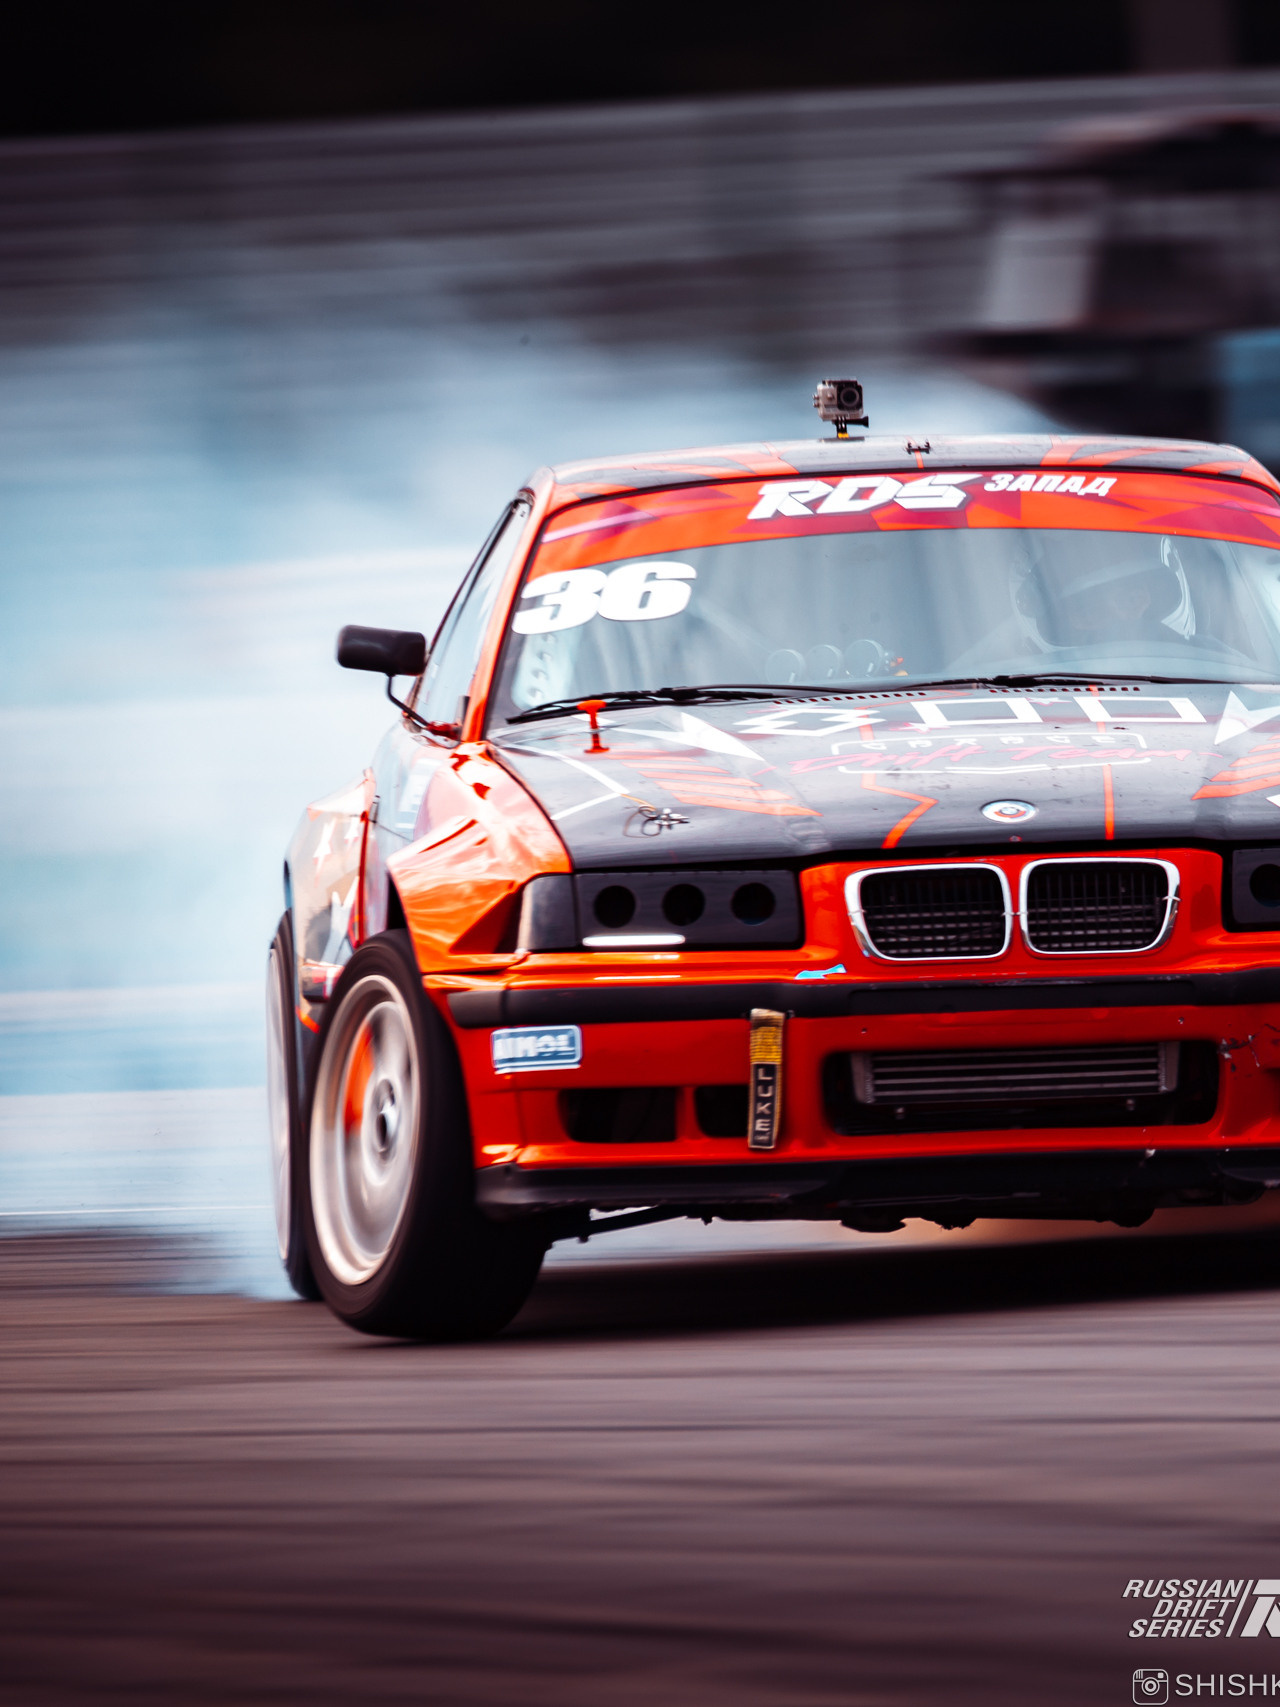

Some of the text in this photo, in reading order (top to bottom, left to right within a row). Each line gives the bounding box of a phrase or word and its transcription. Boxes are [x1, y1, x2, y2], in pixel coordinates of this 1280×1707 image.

[747, 473, 1117, 519] RDS ЗАПАД
[511, 561, 697, 635] 36
[788, 744, 1193, 775] Drift Team
